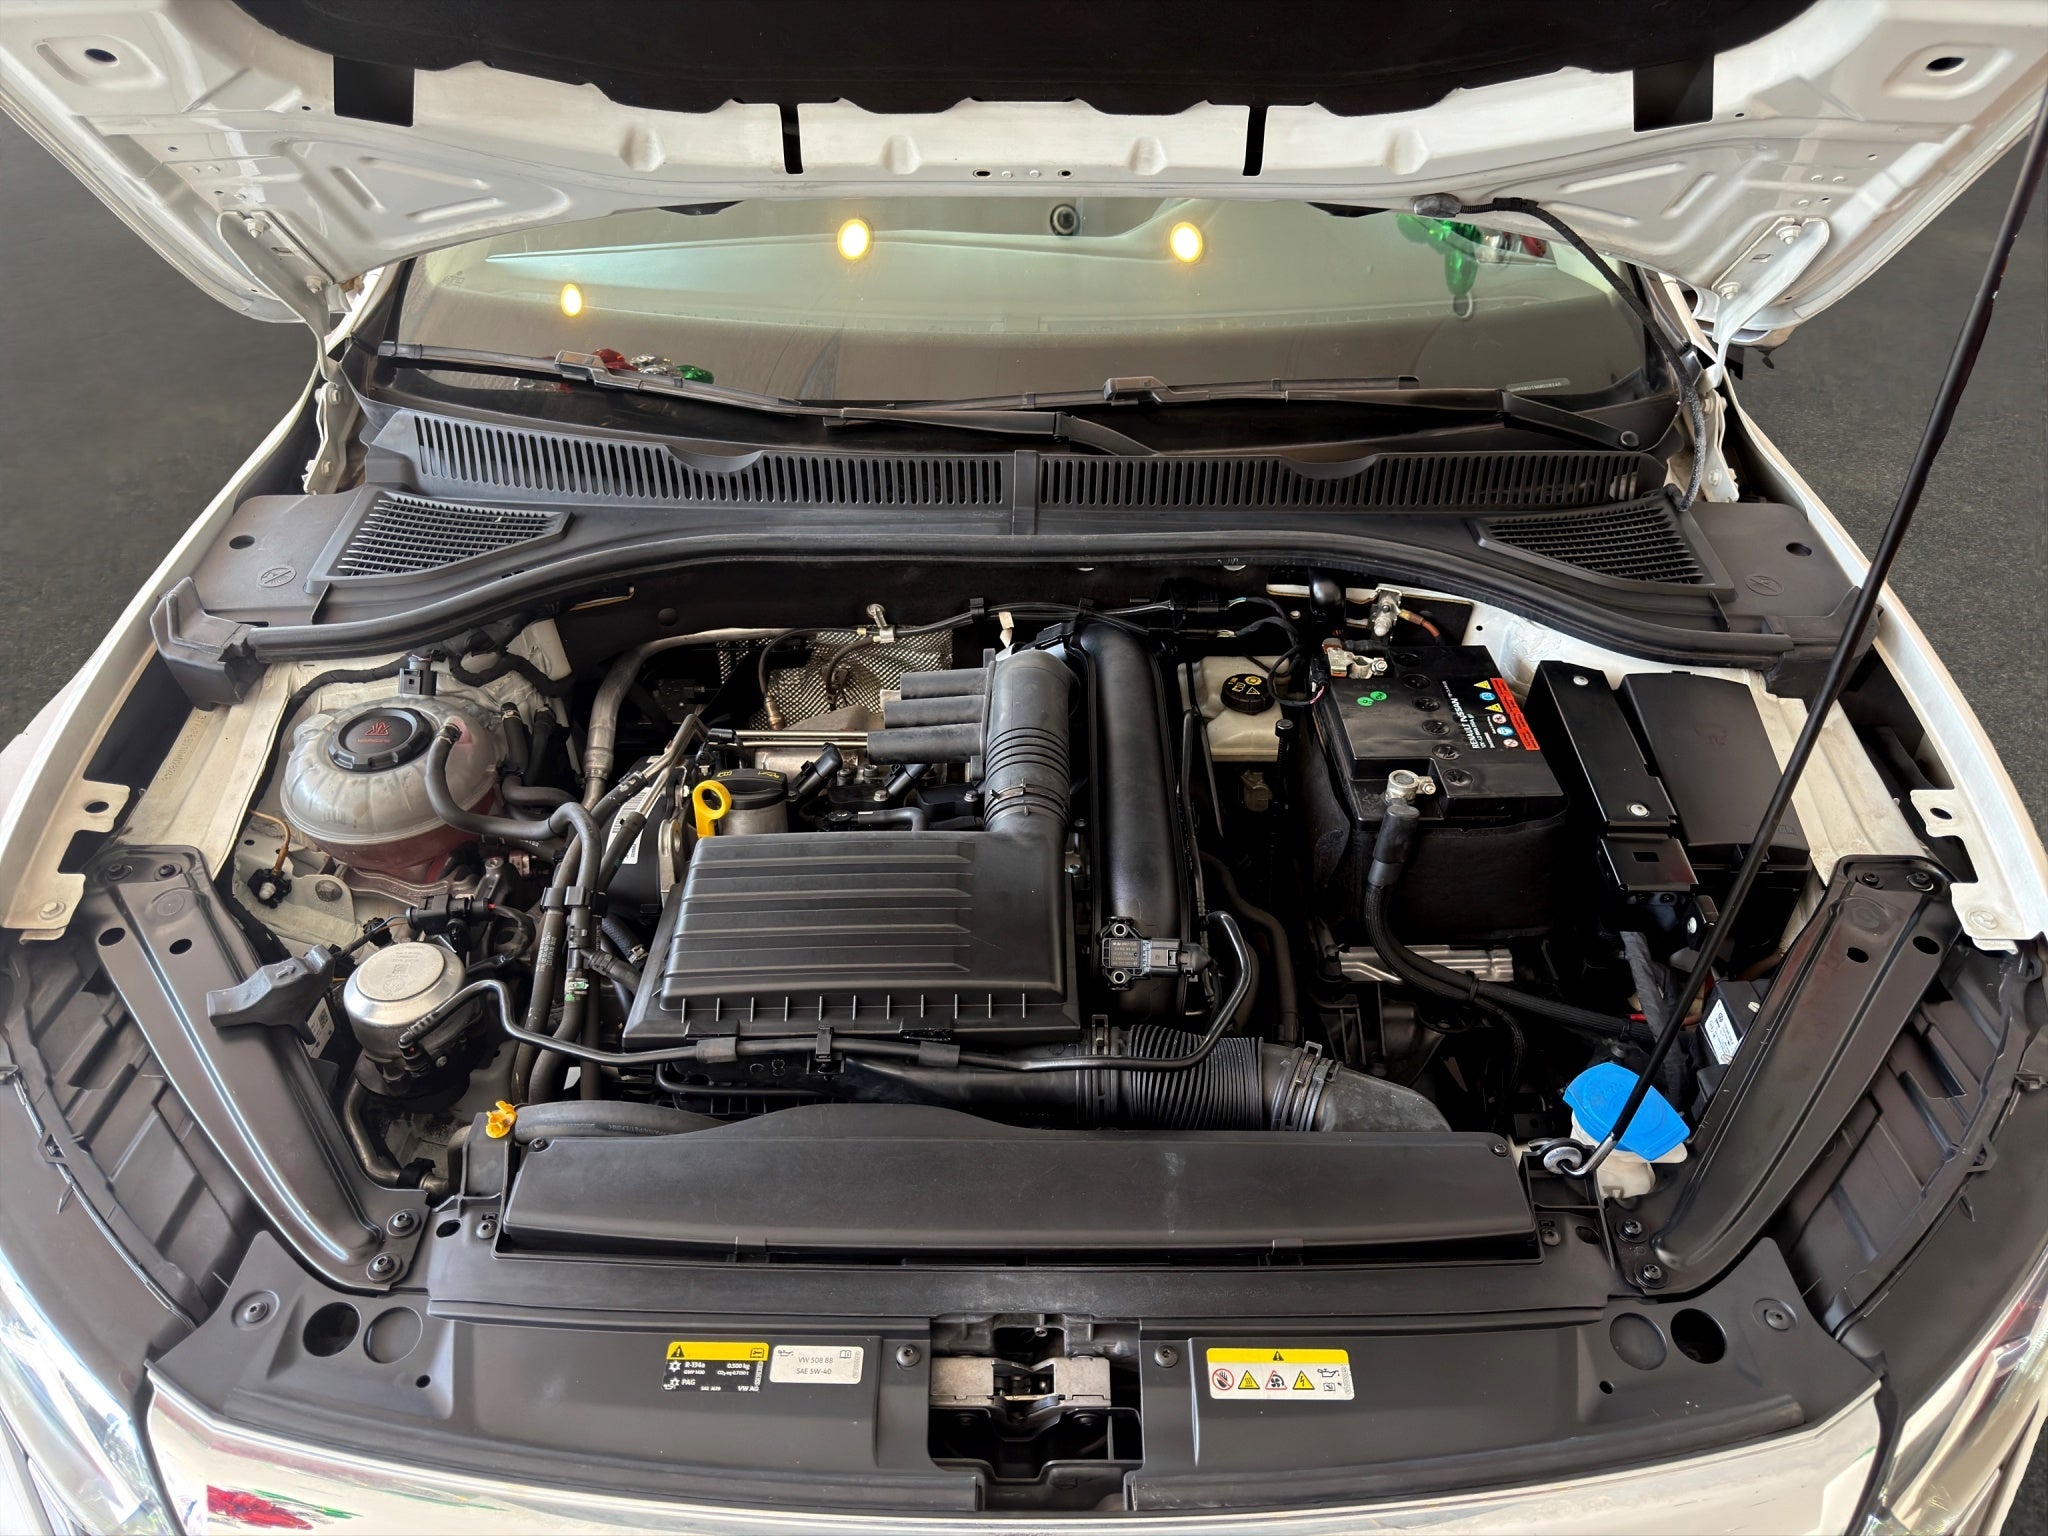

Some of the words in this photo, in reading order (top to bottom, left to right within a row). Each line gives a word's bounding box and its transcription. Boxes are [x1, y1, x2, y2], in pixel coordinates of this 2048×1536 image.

[1450, 697, 1469, 723] NISSAN
[1461, 723, 1480, 749] RENAULT
[681, 1378, 696, 1386] PAG
